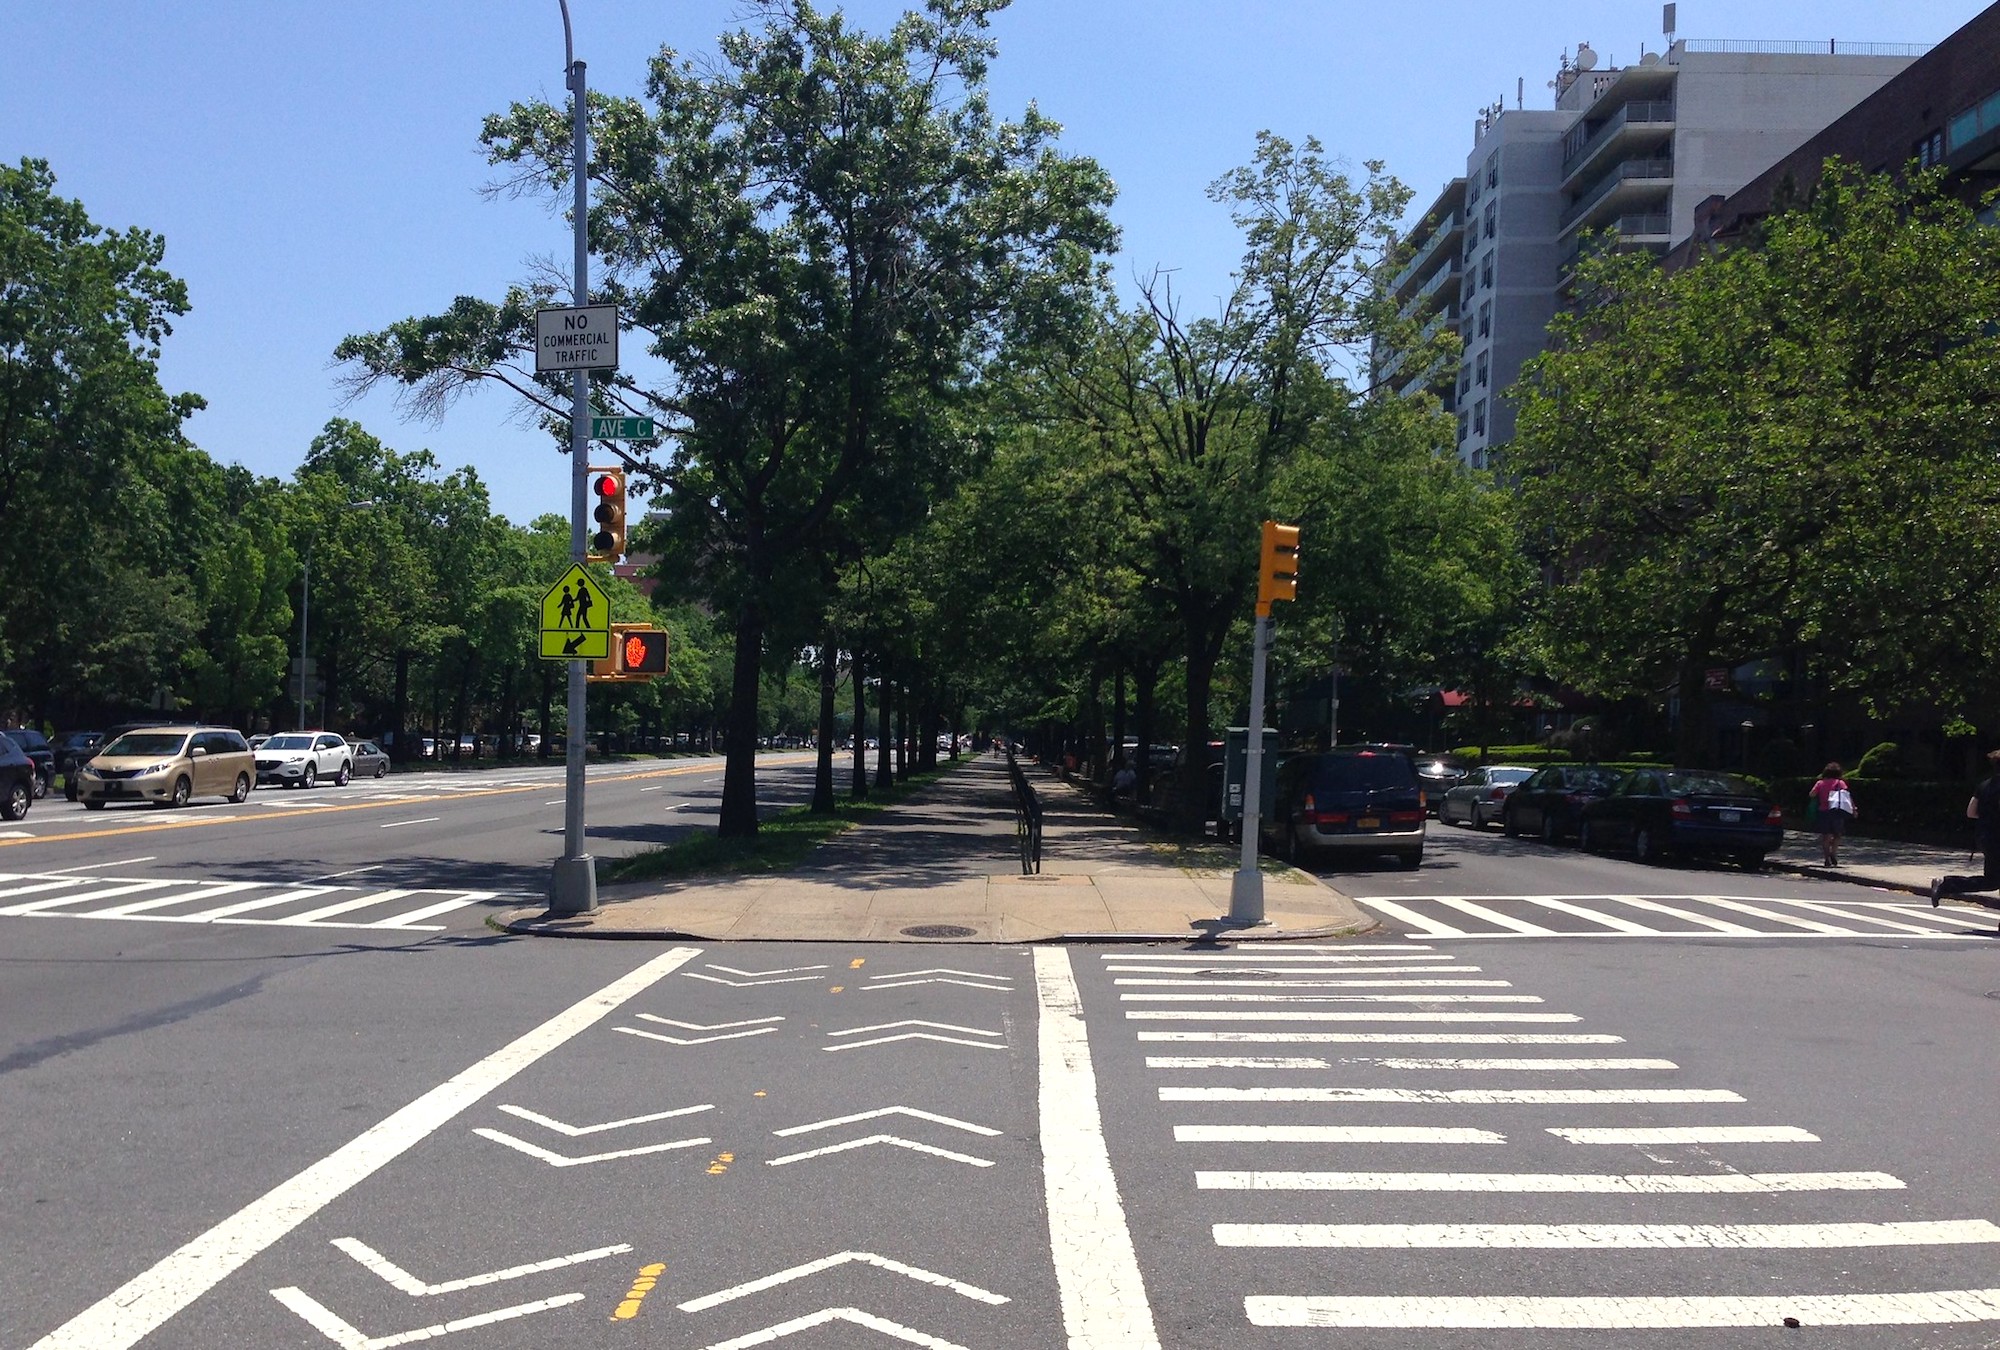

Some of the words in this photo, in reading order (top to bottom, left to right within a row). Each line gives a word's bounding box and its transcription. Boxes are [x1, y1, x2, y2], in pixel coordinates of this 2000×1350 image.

[564, 314, 588, 330] NO
[543, 332, 610, 348] COMMERCIAL
[555, 349, 598, 363] TRAFFIC
[598, 419, 626, 437] AVE
[636, 419, 646, 437] C
